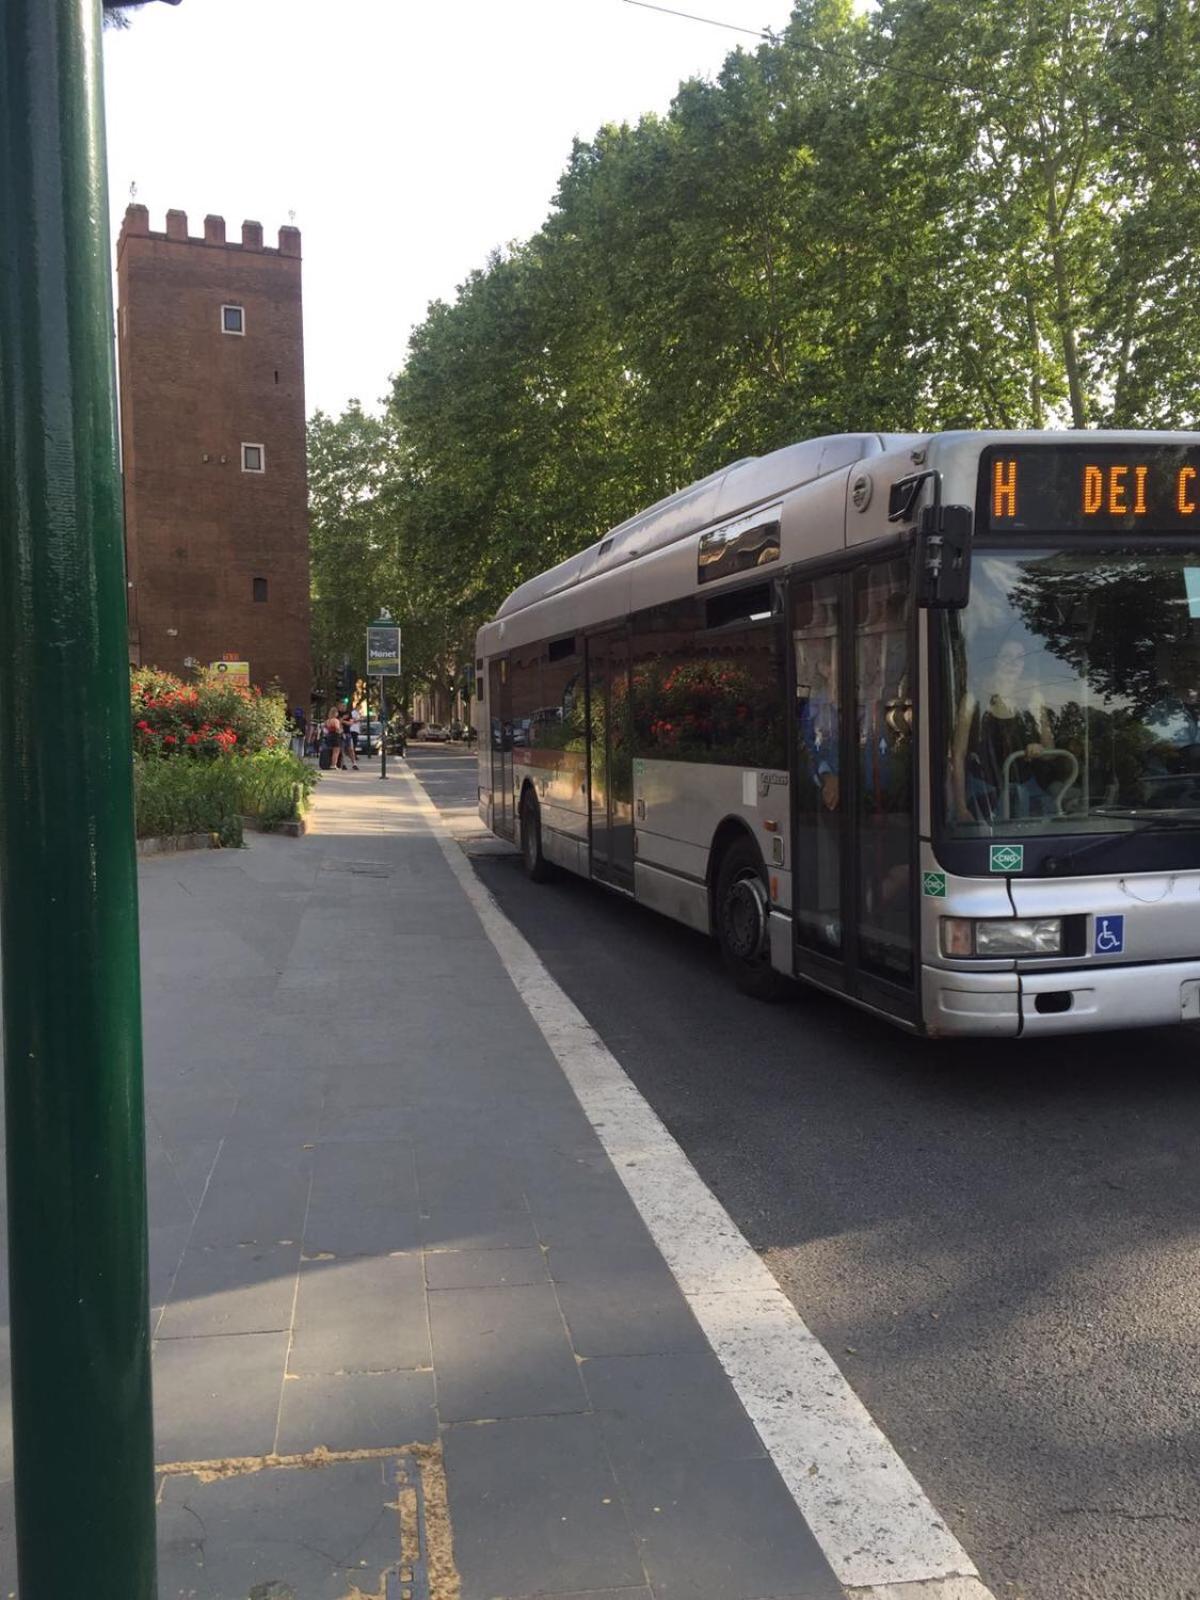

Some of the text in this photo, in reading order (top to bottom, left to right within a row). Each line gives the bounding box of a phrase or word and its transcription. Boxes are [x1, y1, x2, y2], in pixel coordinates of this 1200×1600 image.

[994, 461, 1017, 517] H
[1083, 465, 1197, 514] DEI C
[998, 854, 1016, 862] CNG
